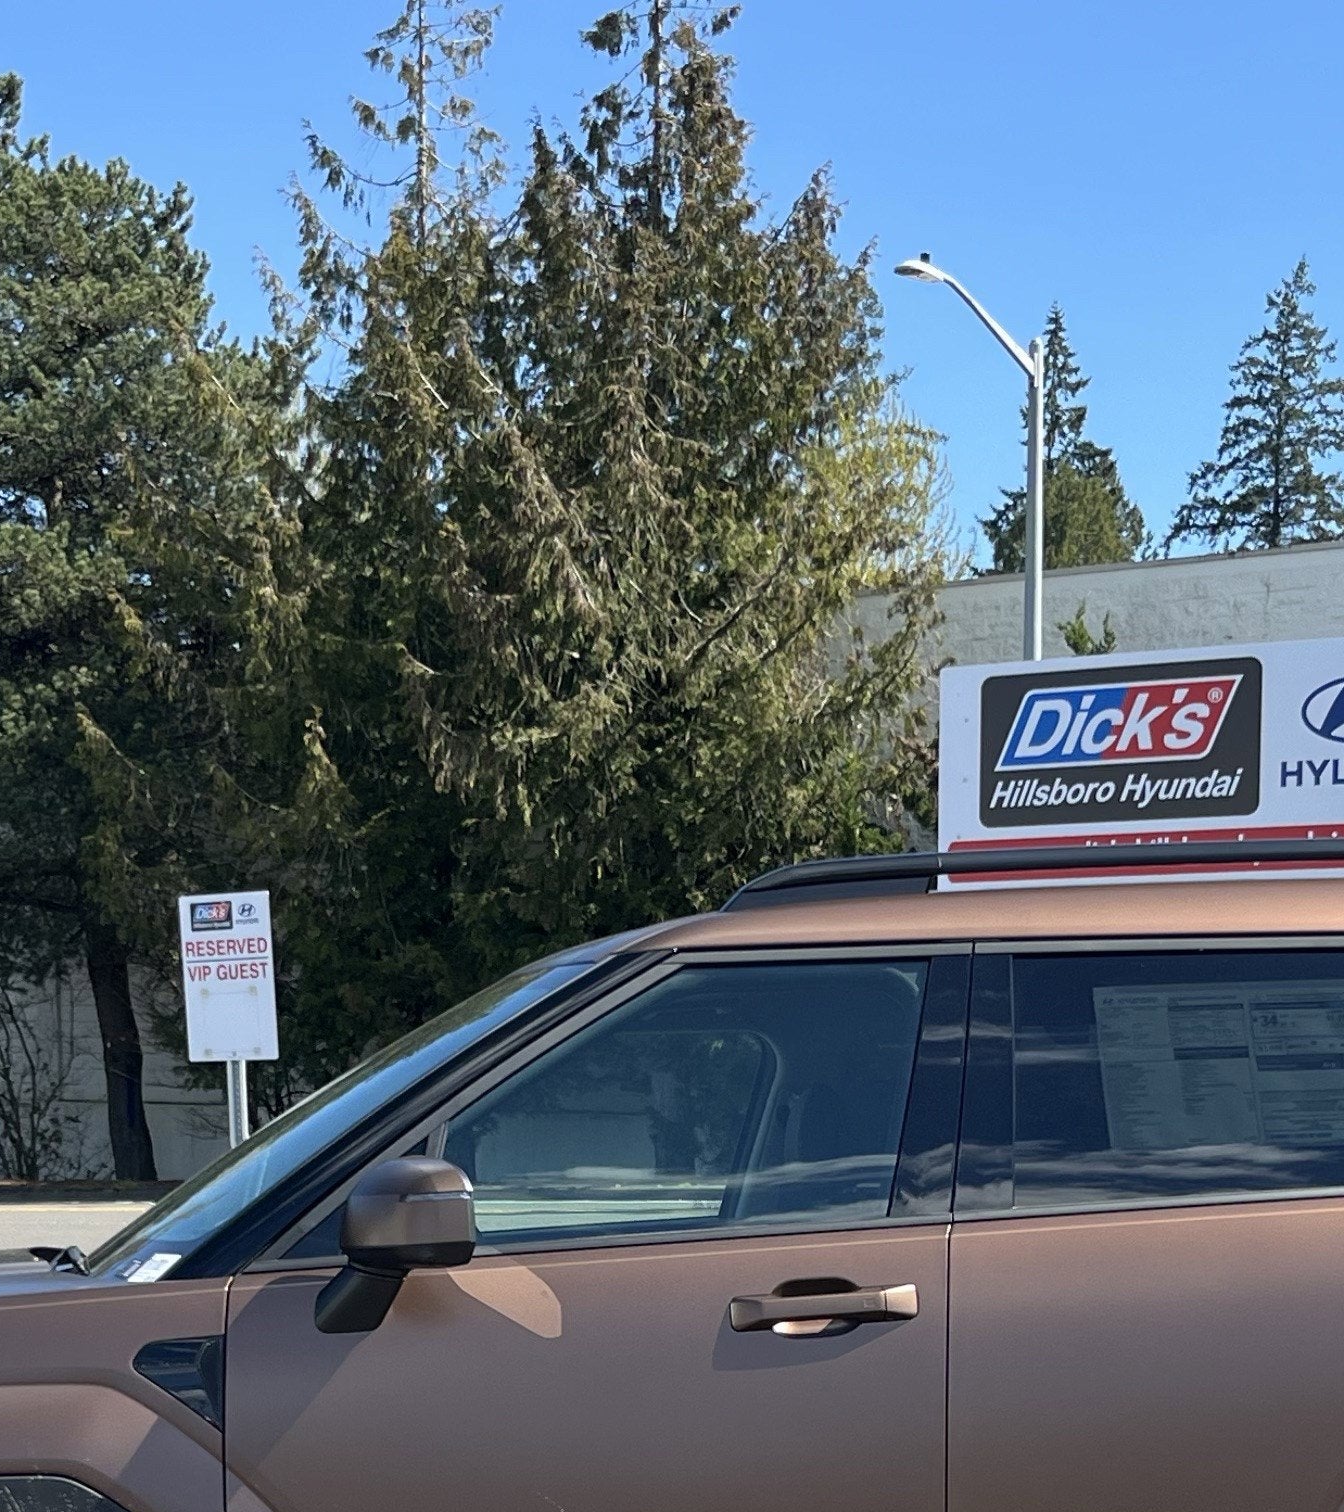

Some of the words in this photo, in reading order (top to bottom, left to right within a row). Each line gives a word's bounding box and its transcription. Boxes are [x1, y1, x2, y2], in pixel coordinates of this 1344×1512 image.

[1014, 687, 1211, 759] Dick's
[989, 777, 1116, 809] Hillsboro
[1119, 767, 1244, 809] Hyundai
[185, 937, 268, 957] RESERVED
[187, 965, 212, 982] VIP
[216, 962, 269, 981] GUEST
